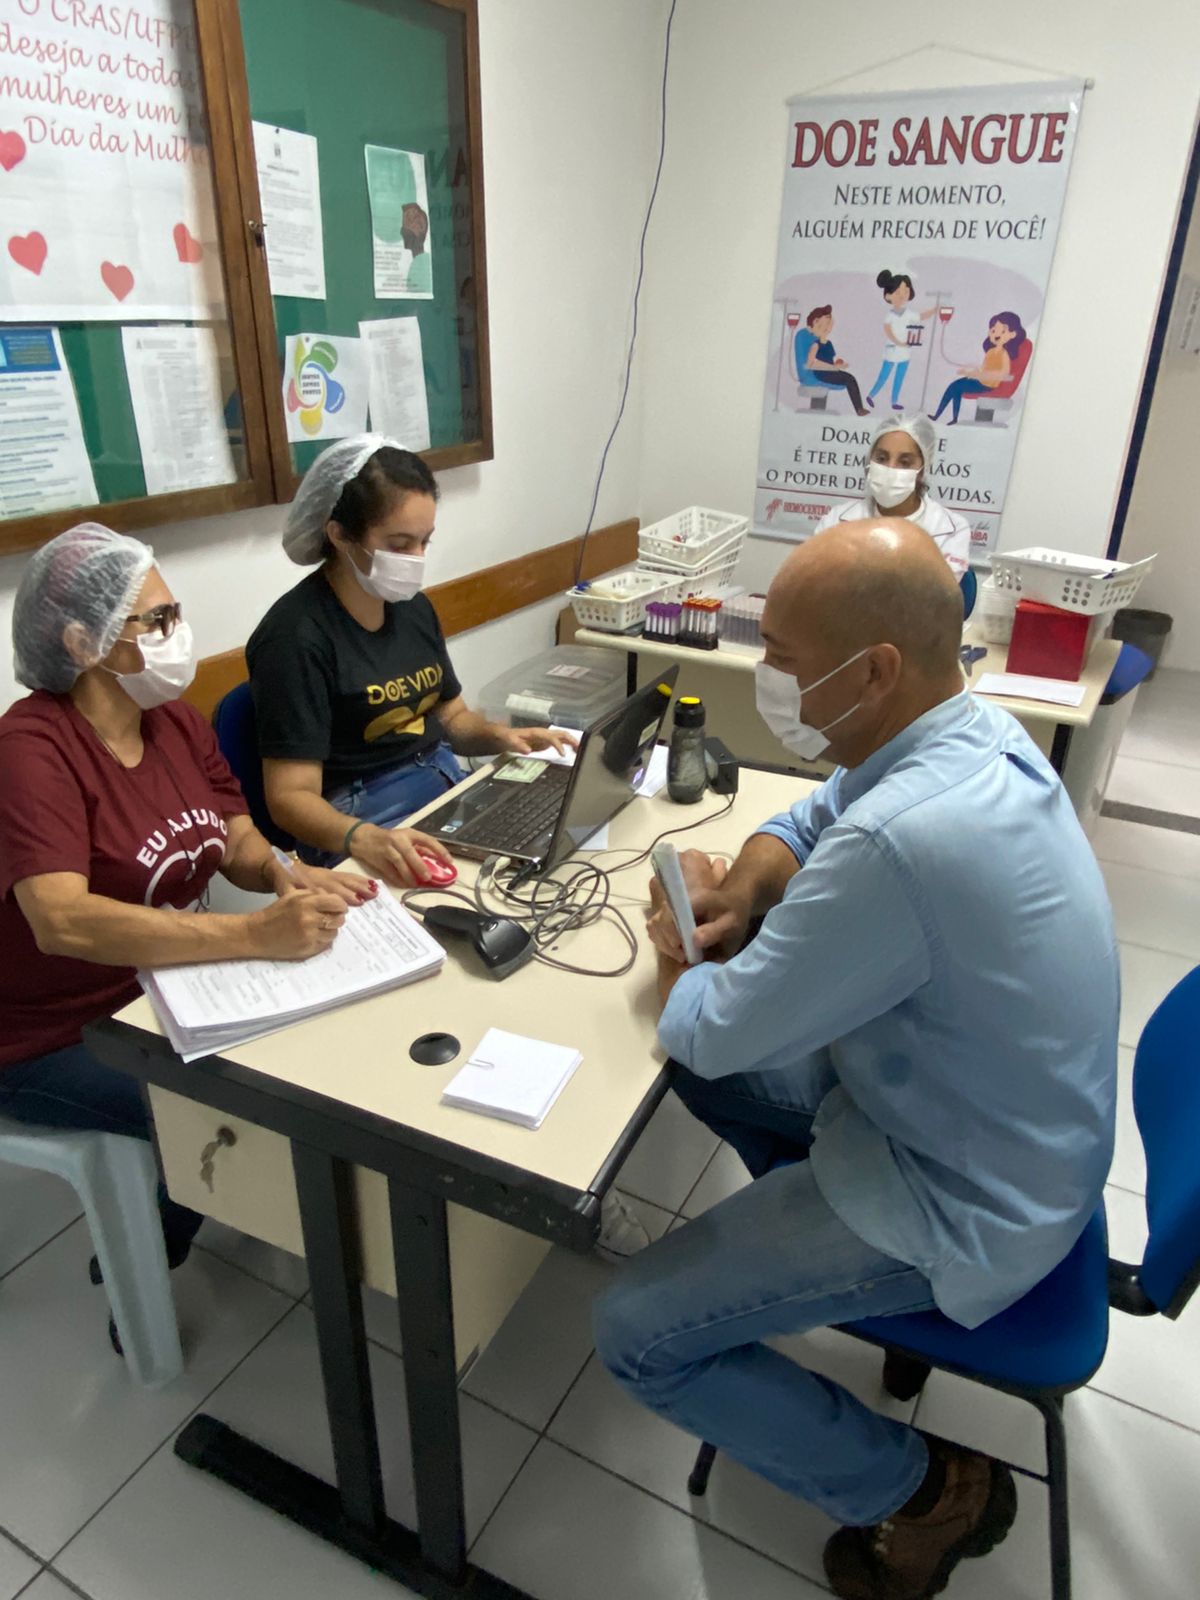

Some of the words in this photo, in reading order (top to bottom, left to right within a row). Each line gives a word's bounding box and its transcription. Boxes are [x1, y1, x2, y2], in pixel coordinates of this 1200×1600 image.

[0, 22, 93, 75] deseja
[98, 53, 121, 74] a
[0, 70, 131, 119] mulheres
[137, 101, 182, 125] um
[24, 115, 84, 147] Dia
[90, 122, 129, 154] da
[791, 119, 880, 168] DOE
[888, 112, 1069, 167] SANGUE
[834, 183, 892, 206] NESTE
[897, 184, 1006, 208] MOMENTO,
[792, 214, 864, 239] ALGUÉM
[871, 219, 946, 239] PRECISA
[952, 219, 978, 240] DE
[986, 215, 1047, 240] VOCÊ!
[821, 426, 871, 446] DOAR
[793, 446, 802, 463] É
[808, 450, 838, 466] TER
[843, 453, 866, 468] EM
[766, 469, 779, 482] O
[784, 471, 838, 489] PODER
[844, 476, 865, 491] DE
[937, 486, 996, 505] VIDAS.
[367, 678, 411, 706] DOE
[136, 830, 167, 869] EU
[167, 808, 228, 837] AJUDO
